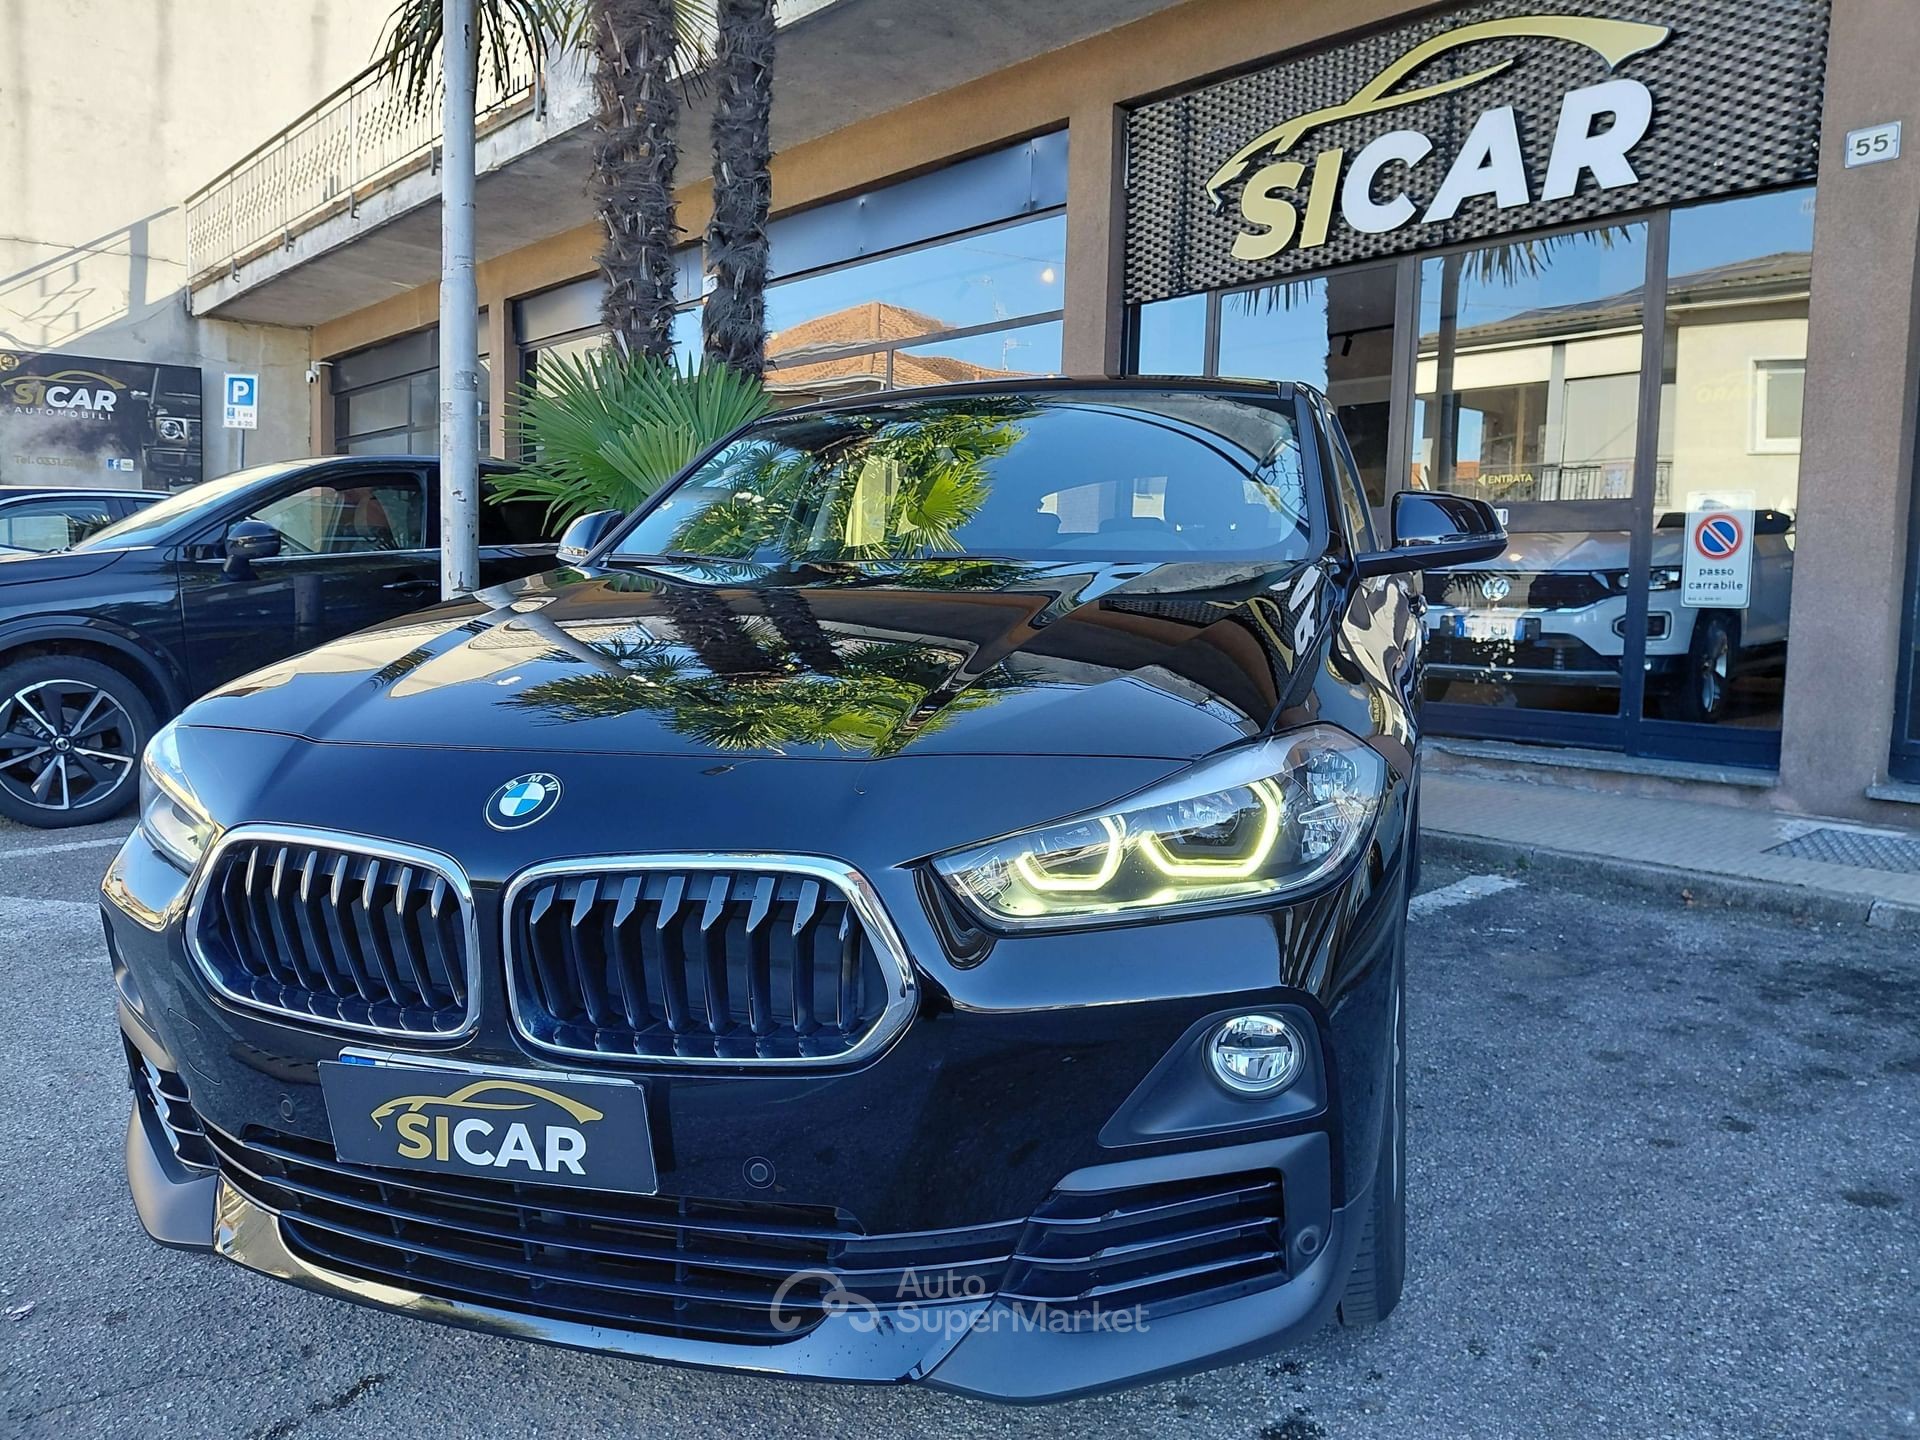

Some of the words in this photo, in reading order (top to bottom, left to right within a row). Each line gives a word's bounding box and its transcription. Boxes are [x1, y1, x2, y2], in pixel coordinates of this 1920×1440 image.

[1856, 133, 1889, 157] 55
[1230, 79, 1653, 262] SICAR
[14, 383, 118, 412] SICAR
[232, 380, 250, 403] P
[15, 406, 112, 420] AUTOMOBILI
[1487, 473, 1534, 485] ENTRATA
[1699, 567, 1735, 577] passo
[1688, 580, 1744, 591] carrabile
[397, 1111, 587, 1176] SICAR
